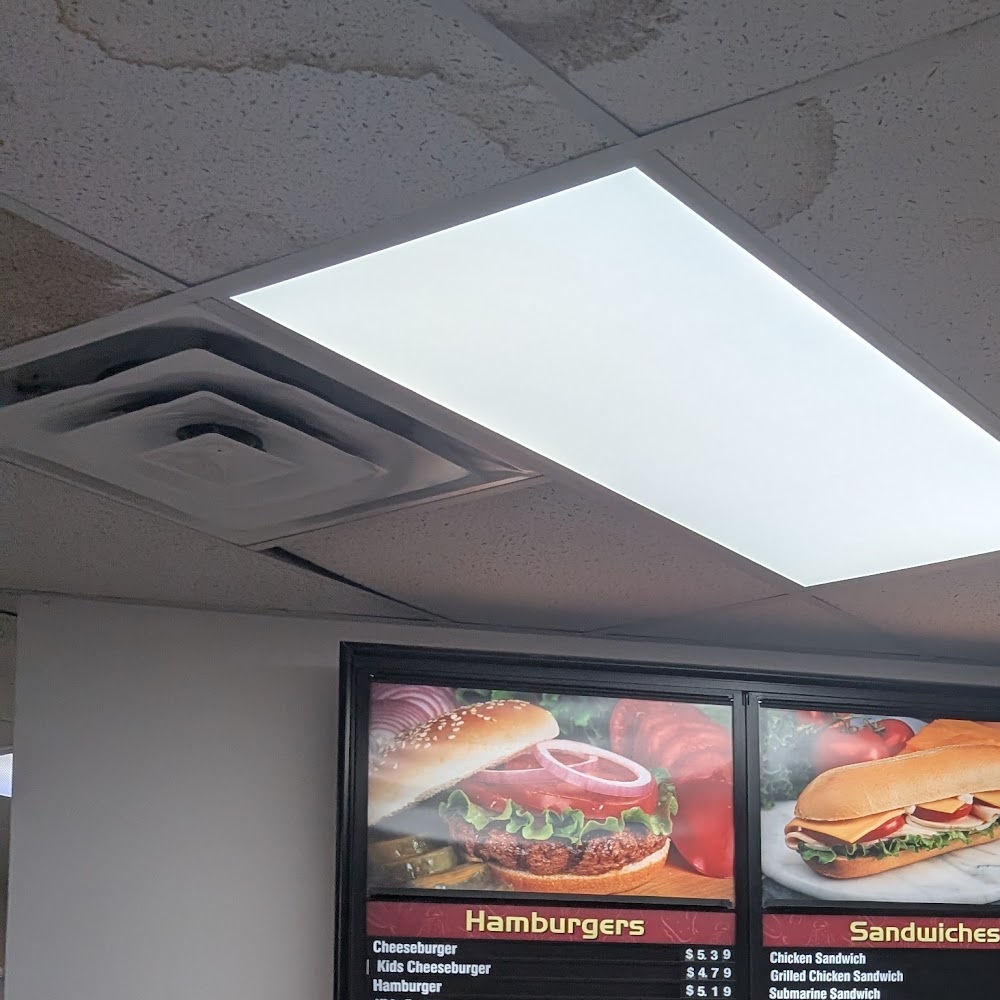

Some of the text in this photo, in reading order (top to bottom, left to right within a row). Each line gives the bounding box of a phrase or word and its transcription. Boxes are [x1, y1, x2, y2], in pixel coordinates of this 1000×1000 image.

[465, 909, 645, 940] Hamburgers
[850, 921, 1000, 944] Sandwiches
[373, 940, 458, 957] Cheeseburger
[770, 952, 812, 964] Chicken
[815, 952, 866, 964] Sandwich
[377, 960, 405, 973] Kids
[407, 960, 492, 977] Cheeseburger
[770, 970, 806, 982] Grilled
[809, 970, 851, 982] Chicken
[853, 970, 903, 982] Sandwich
[373, 979, 442, 995] Hamburger
[769, 987, 827, 1000] Submarine
[829, 987, 881, 1000] Sandwich
